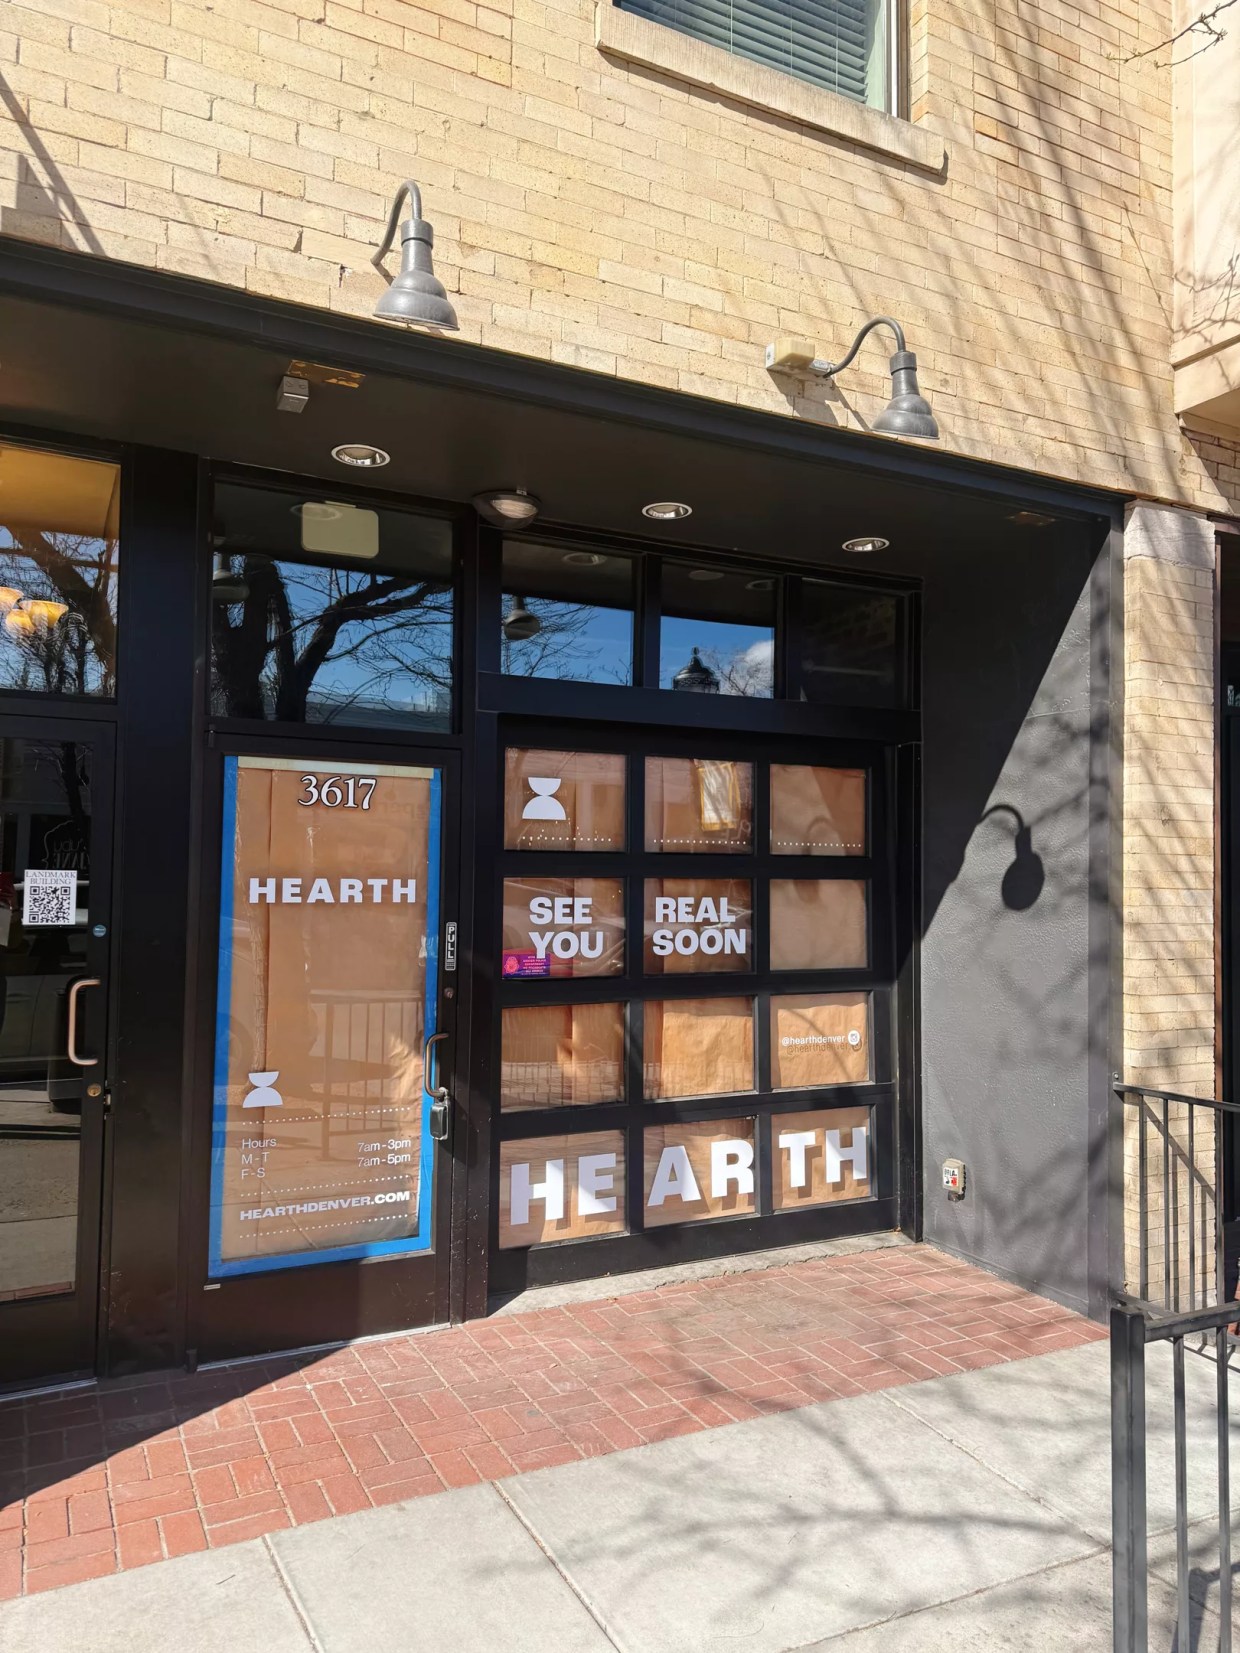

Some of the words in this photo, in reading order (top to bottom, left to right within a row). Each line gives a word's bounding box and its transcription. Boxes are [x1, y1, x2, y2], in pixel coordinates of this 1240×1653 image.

[298, 774, 377, 810] 3617
[25, 871, 76, 879] LANDMARK
[249, 878, 416, 904] HEARTH
[529, 896, 593, 925] SEE
[655, 896, 736, 923] REAL
[447, 926, 455, 959] PULL
[528, 930, 604, 959] YOU
[652, 928, 747, 956] SOON
[782, 1035, 845, 1047] @hearthdenver
[242, 1138, 277, 1150] Hours
[509, 1126, 868, 1226] HEARTH
[239, 1190, 411, 1221] HEARTHDENVER.COM
